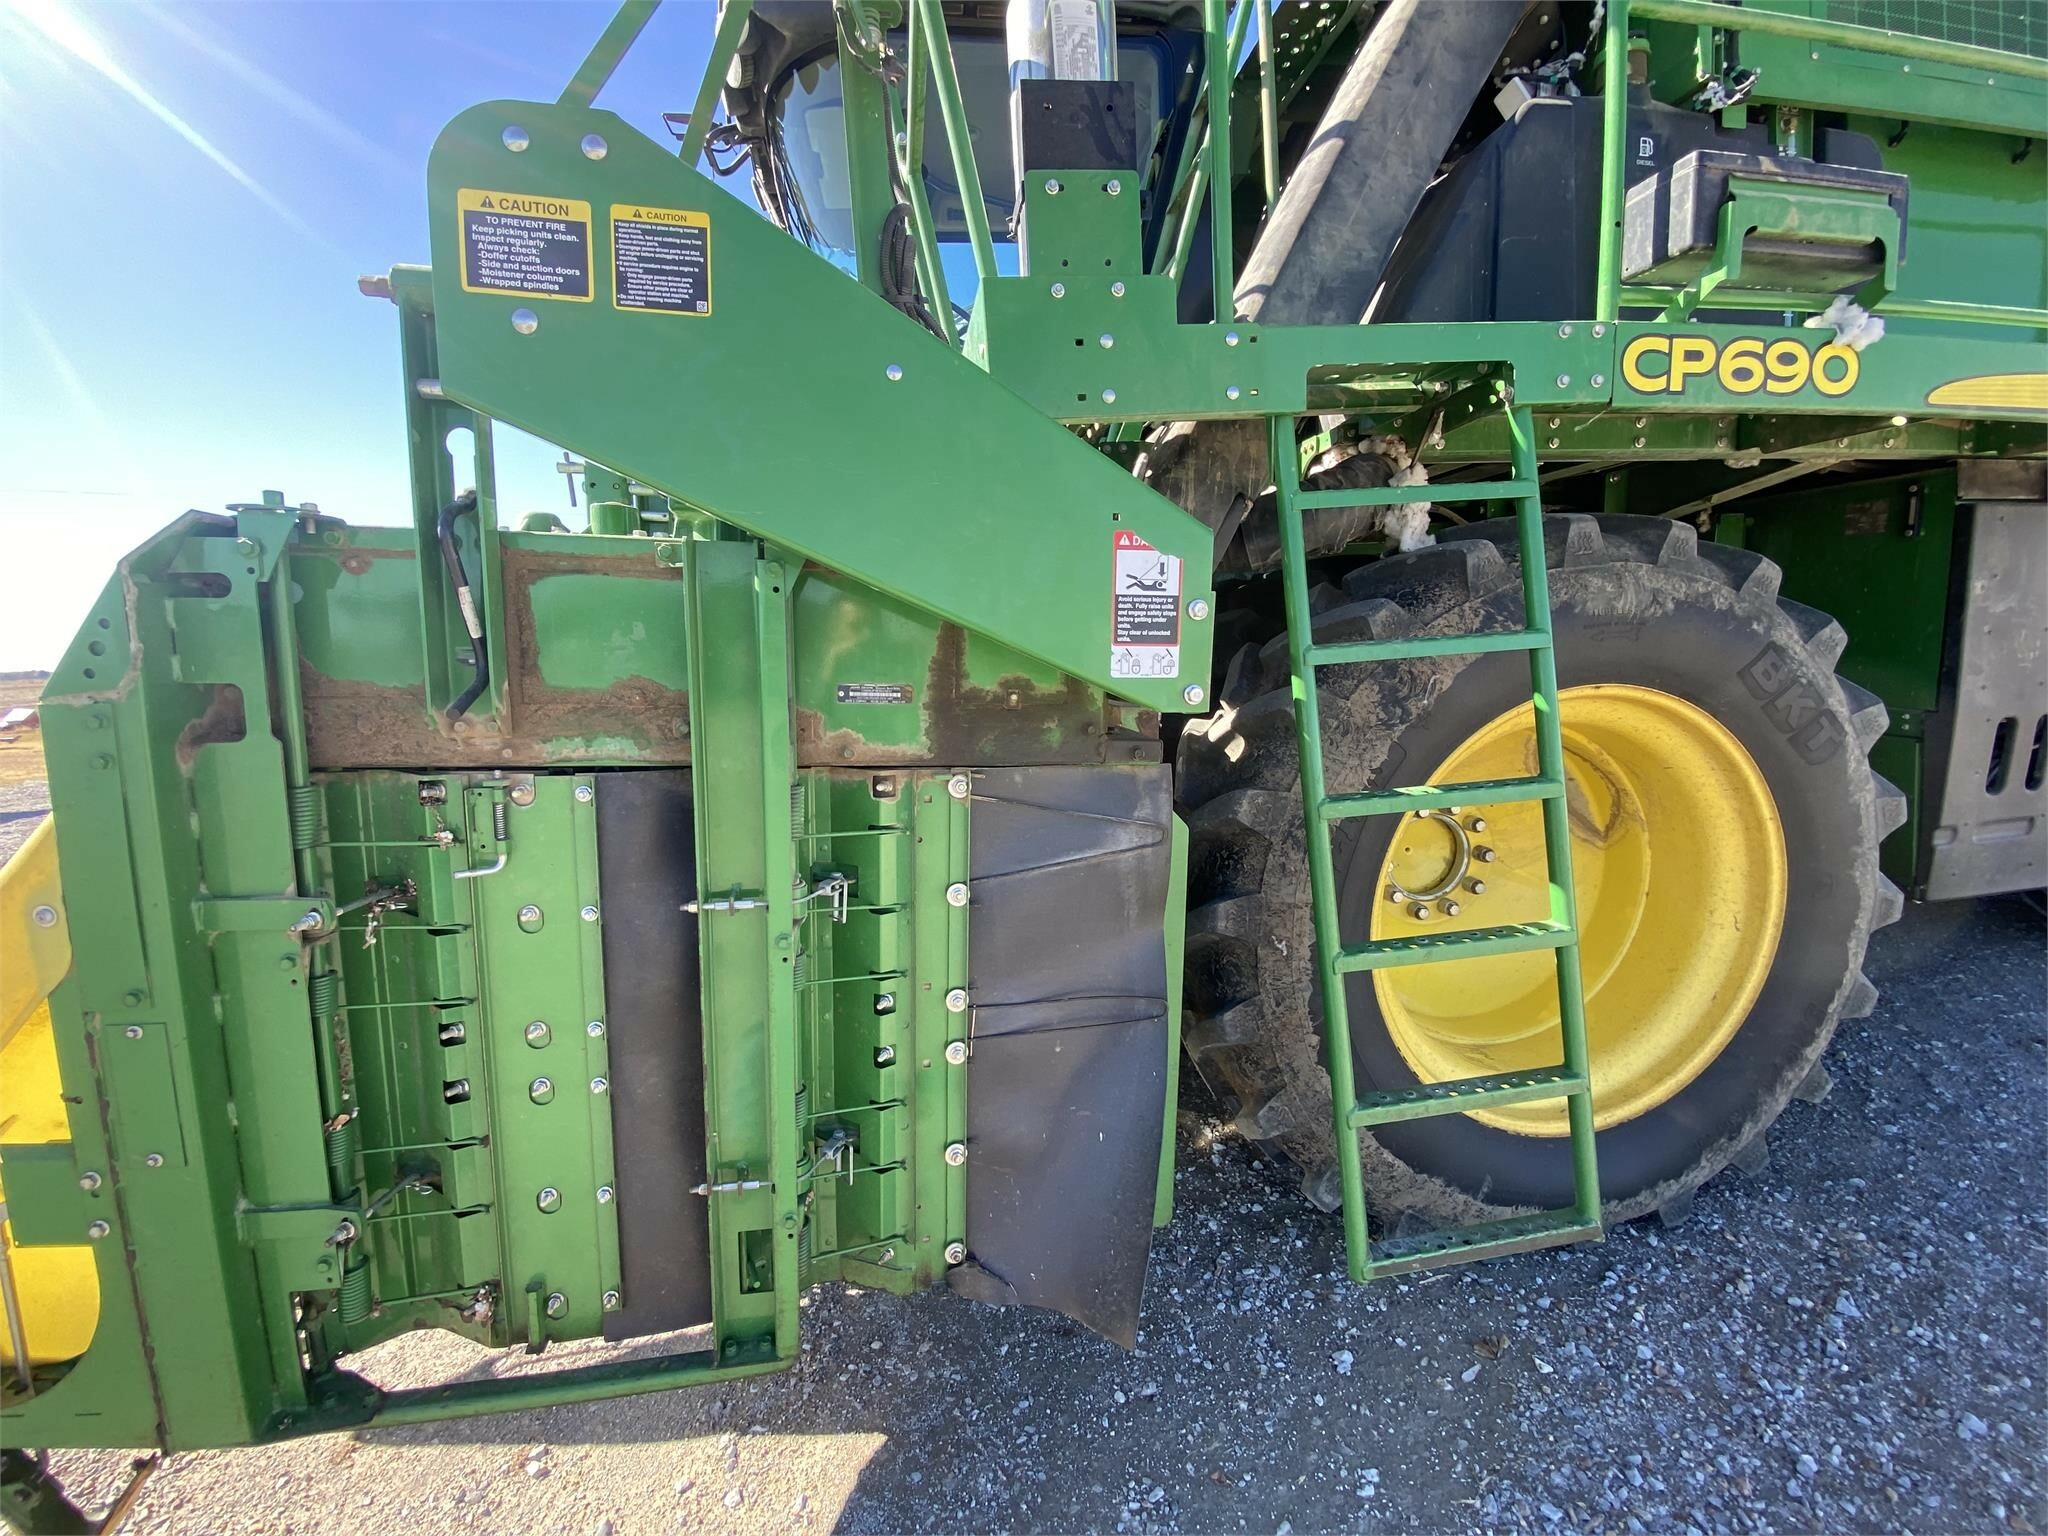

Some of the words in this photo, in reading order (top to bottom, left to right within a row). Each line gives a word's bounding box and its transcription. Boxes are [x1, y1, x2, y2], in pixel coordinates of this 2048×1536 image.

[500, 199, 569, 217] CAUTION
[486, 216, 499, 225] TO
[501, 218, 543, 229] PREVENT
[546, 222, 566, 231] FIRE
[647, 212, 687, 223] CAUTION
[472, 224, 494, 234] Keep
[497, 227, 528, 238] picking
[531, 231, 552, 239] units
[554, 233, 579, 242] clean.
[472, 234, 504, 244] Inspect
[507, 237, 547, 249] regularly.
[478, 243, 509, 253] Always
[512, 246, 540, 255] check:
[478, 251, 507, 260] -Doffer
[510, 254, 540, 263] cutoffs
[478, 260, 500, 268] -Side
[522, 264, 553, 273] suction
[556, 267, 580, 276] doors
[478, 268, 524, 278] -Moistener
[527, 273, 563, 282] columns
[480, 277, 521, 288] -Wrapped
[523, 281, 559, 292] spindles
[1621, 333, 1861, 397] CP690
[1736, 640, 1848, 766] BKT
